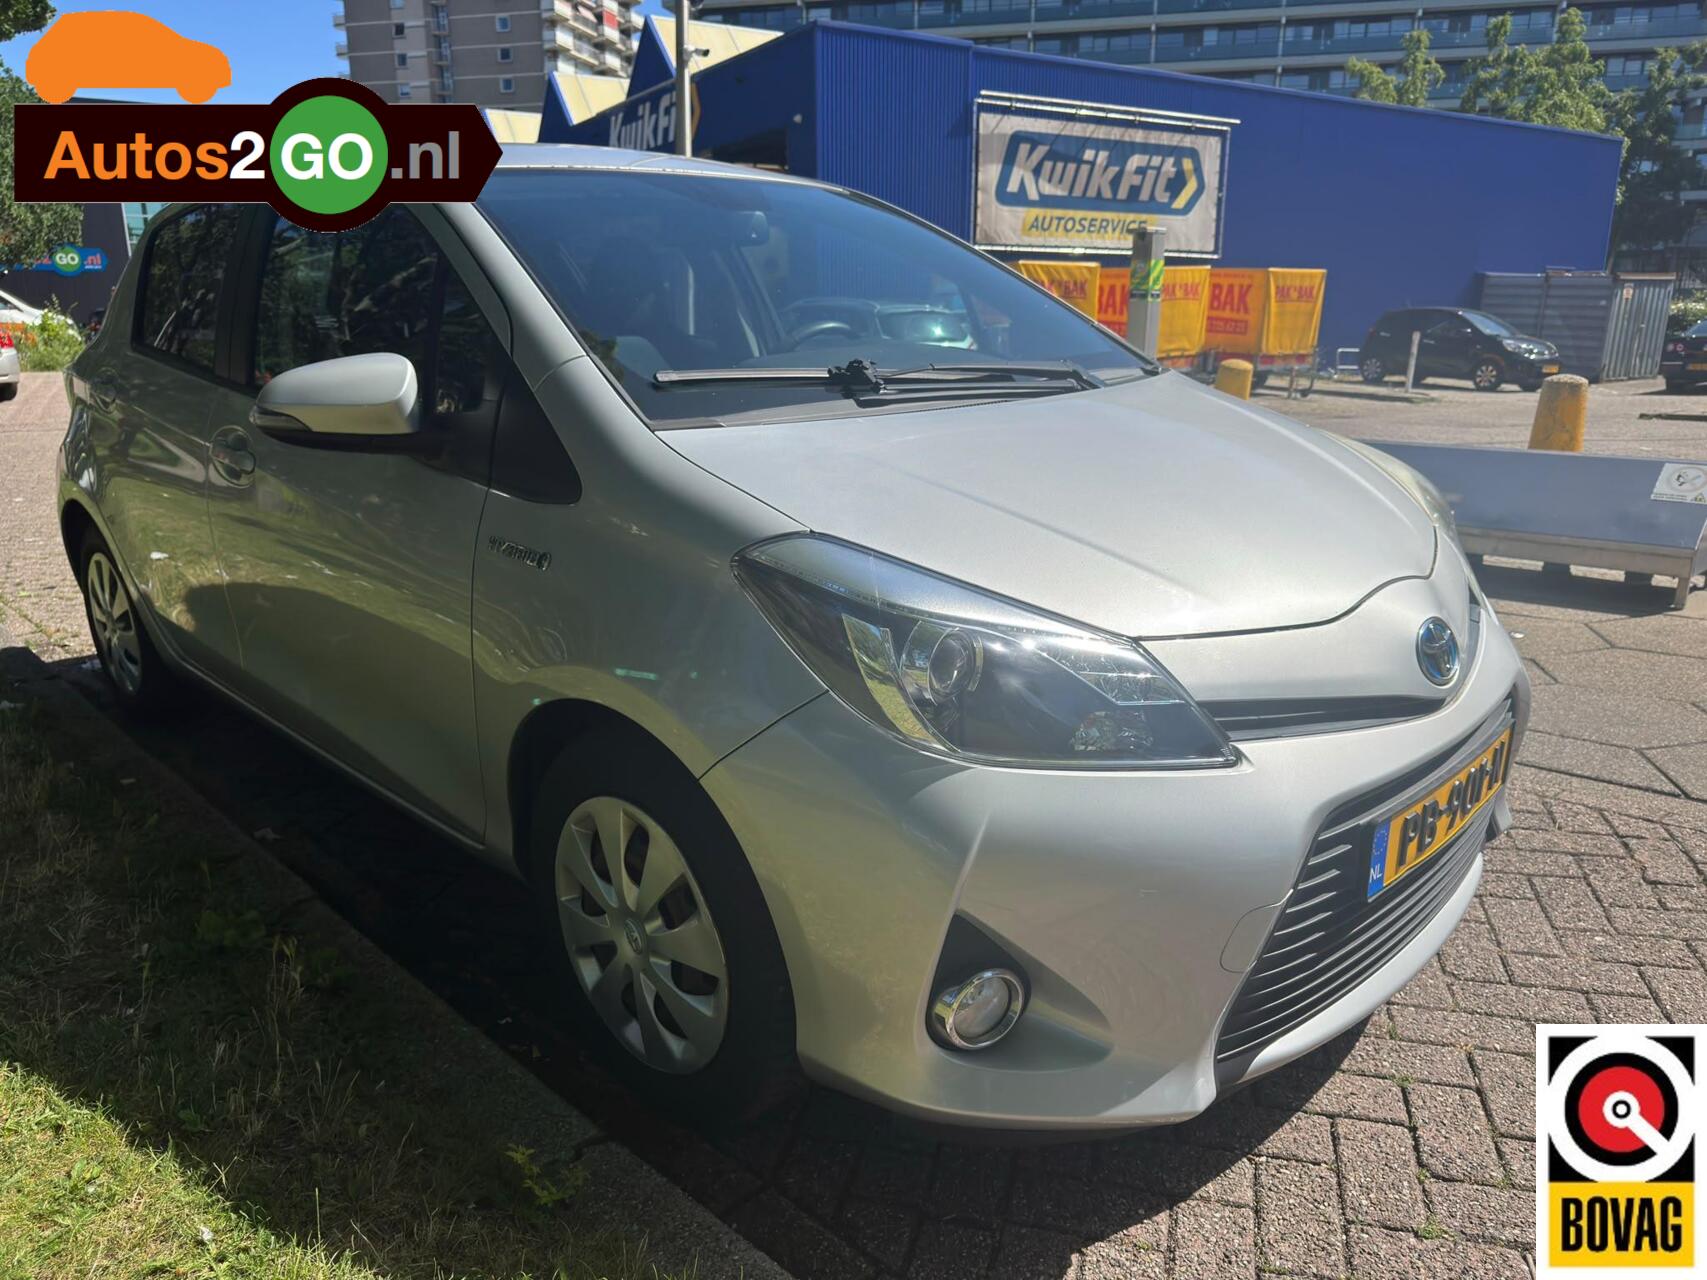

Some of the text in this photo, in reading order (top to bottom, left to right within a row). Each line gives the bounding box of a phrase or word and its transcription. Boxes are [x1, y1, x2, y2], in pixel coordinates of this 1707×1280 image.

[609, 91, 679, 150] KwikFi
[1028, 213, 1148, 234] AUTOSERVICE
[1210, 283, 1253, 314] BAK
[1369, 863, 1382, 883] NL
